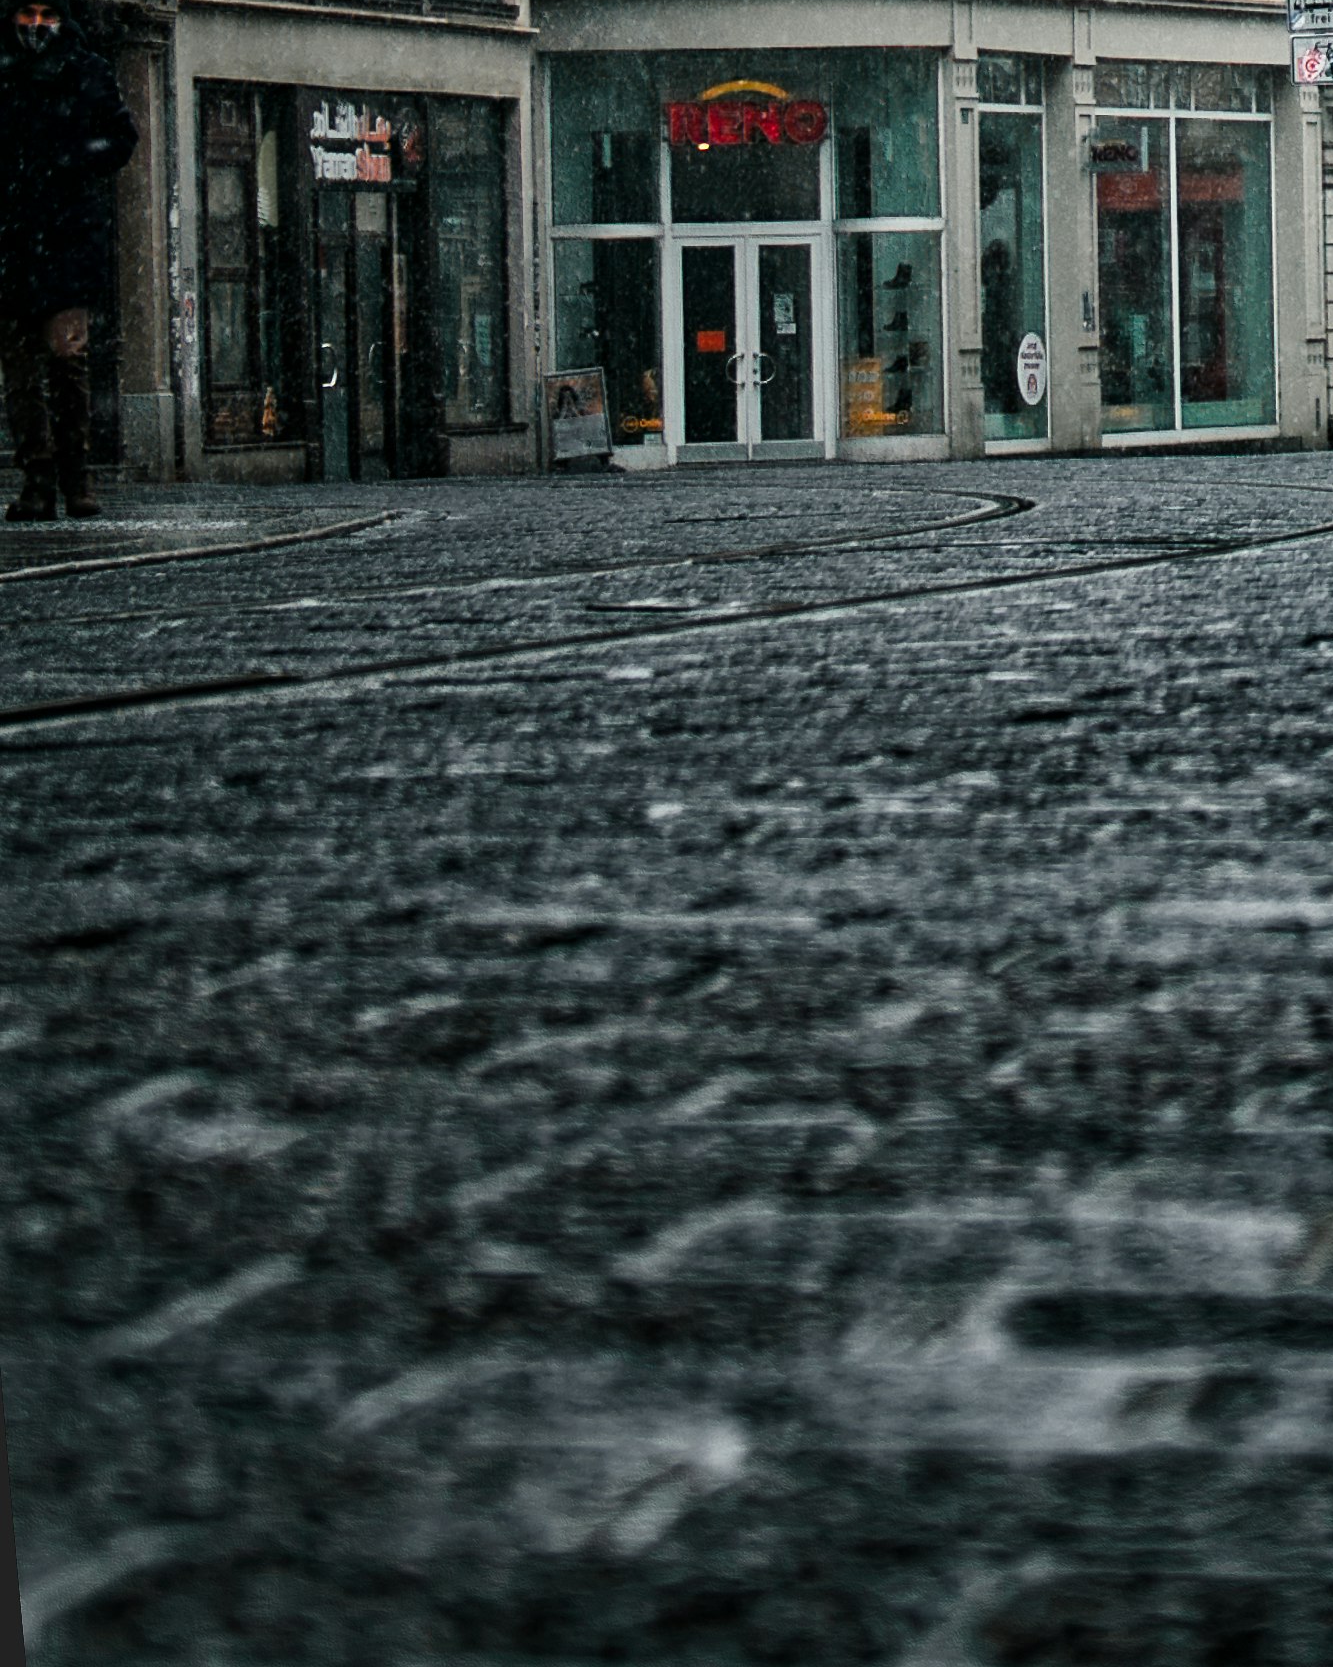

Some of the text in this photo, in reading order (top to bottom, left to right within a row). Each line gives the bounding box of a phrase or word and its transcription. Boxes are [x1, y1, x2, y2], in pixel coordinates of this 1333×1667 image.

[1310, 13, 1331, 24] frei
[667, 99, 828, 145] RENO
[1091, 144, 1138, 163] RENO
